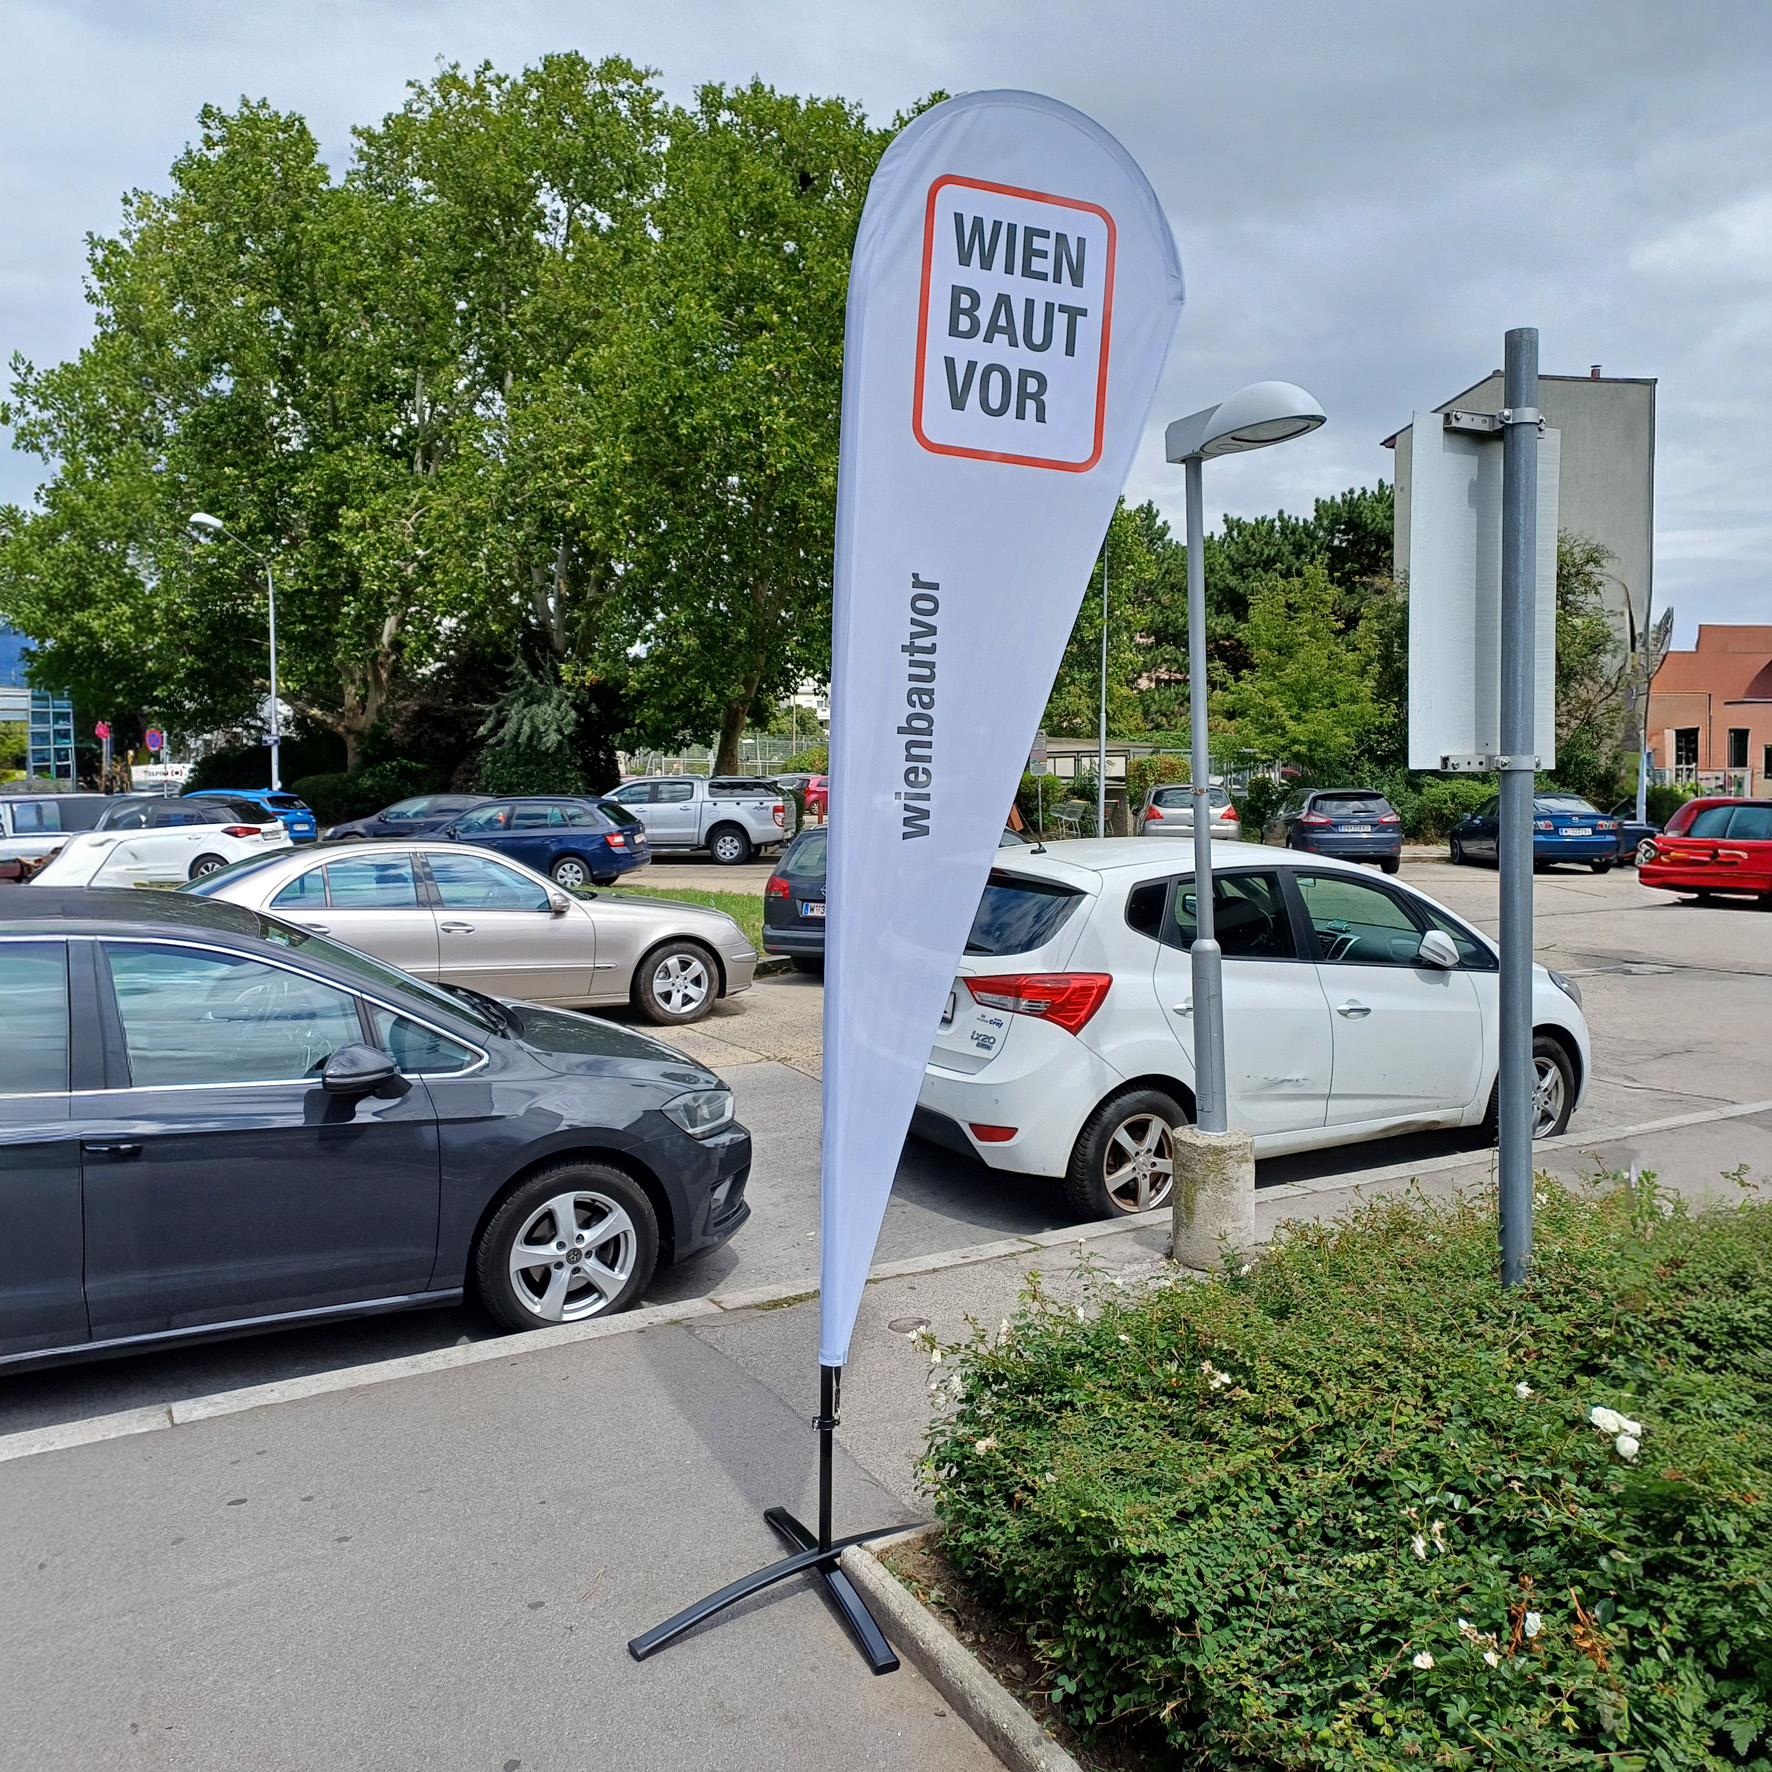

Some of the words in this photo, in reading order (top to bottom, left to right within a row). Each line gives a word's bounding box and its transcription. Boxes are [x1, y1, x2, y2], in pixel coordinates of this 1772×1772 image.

[953, 211, 1087, 288] WIEN
[948, 284, 1088, 357] BAUT
[943, 355, 1048, 424] VOR
[894, 572, 940, 841] wienbautvor
